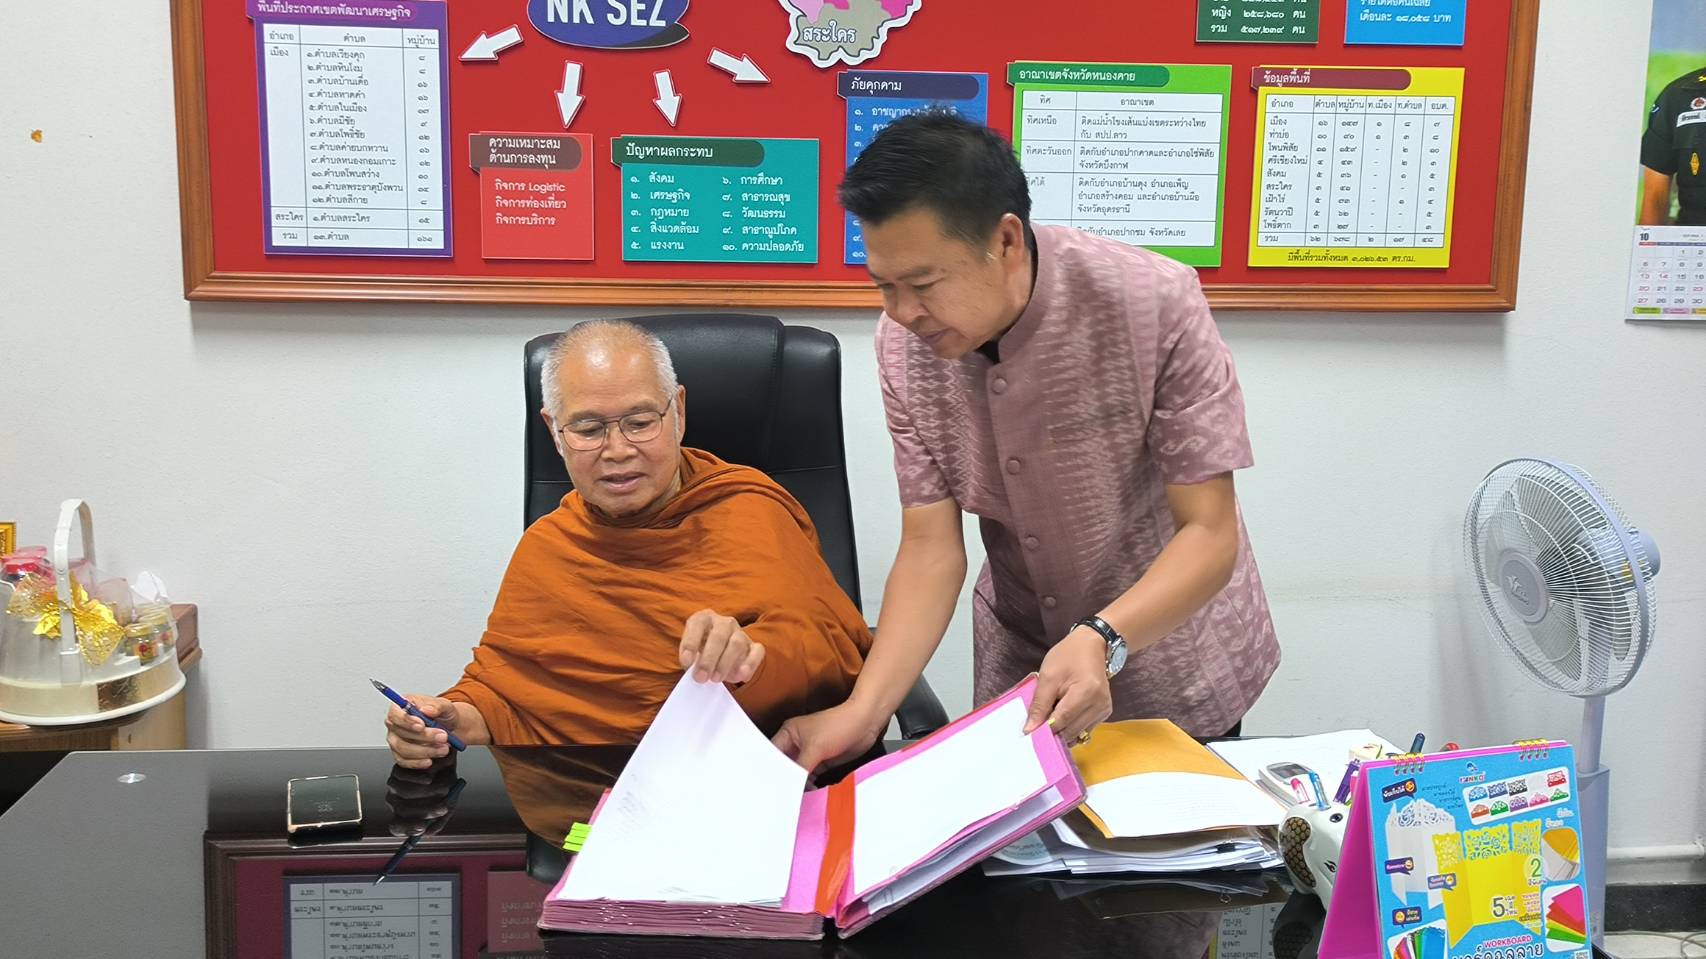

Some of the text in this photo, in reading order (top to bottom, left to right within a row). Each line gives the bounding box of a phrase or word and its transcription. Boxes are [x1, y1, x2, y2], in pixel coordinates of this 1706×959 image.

[546, 0, 667, 27] NK SEZ
[1210, 4, 1232, 20] หญิง
[1360, 9, 1392, 22] เดือนละ
[1433, 13, 1453, 23] บาท
[802, 19, 857, 43] สระใคร
[1210, 23, 1228, 33] รวม
[268, 30, 437, 49] อำเภอ ตำบล หมู่บ้าน
[269, 46, 290, 58] เมือง
[1018, 67, 1137, 83] อาณาเขตจังหวัดหนองคาย
[1263, 68, 1311, 88] ข้อมูลพื้นที่
[850, 76, 903, 95] ภัยคุกคาม
[1120, 98, 1155, 107] อาณาเขต
[1271, 98, 1294, 108] อำเภอ
[1315, 98, 1336, 109] ตำบล
[1338, 98, 1365, 112] หมู่บ้าน
[1026, 114, 1057, 125] ทิศเหนือ
[1269, 115, 1288, 126] เมือง
[1268, 128, 1290, 139] ท่าบ่อ
[488, 136, 561, 150] ความเหมาะสม
[1025, 145, 1072, 156] ทิศตะวันออก
[625, 142, 714, 160] ปัญหาผลกระทบ
[488, 148, 557, 170] ด้านการลงทุน
[648, 171, 675, 184] สังคม
[740, 172, 784, 186] การศึกษา
[1266, 167, 1287, 178] สังคม
[494, 178, 566, 194] กิจการ Logistic
[1265, 180, 1293, 191] สระใคร
[494, 192, 568, 209] กิจการท่องเที่ยว
[649, 188, 691, 204] เศรษฐกิจ
[741, 192, 792, 207] สาธารณสุข
[274, 211, 305, 223] สระใคร
[494, 212, 557, 226] กิจการบริการ
[650, 207, 690, 219] กฎหมาย
[741, 206, 787, 219] วัฒนธรรม
[649, 217, 700, 234] สิ่งแวดล้อม
[281, 230, 299, 241] รวม
[650, 240, 685, 251] แรงงาน
[741, 238, 805, 253] ความปลอดภัย
[1530, 857, 1542, 878] 2
[1492, 896, 1506, 918] 5
[1483, 935, 1532, 950] WORKBOARD
